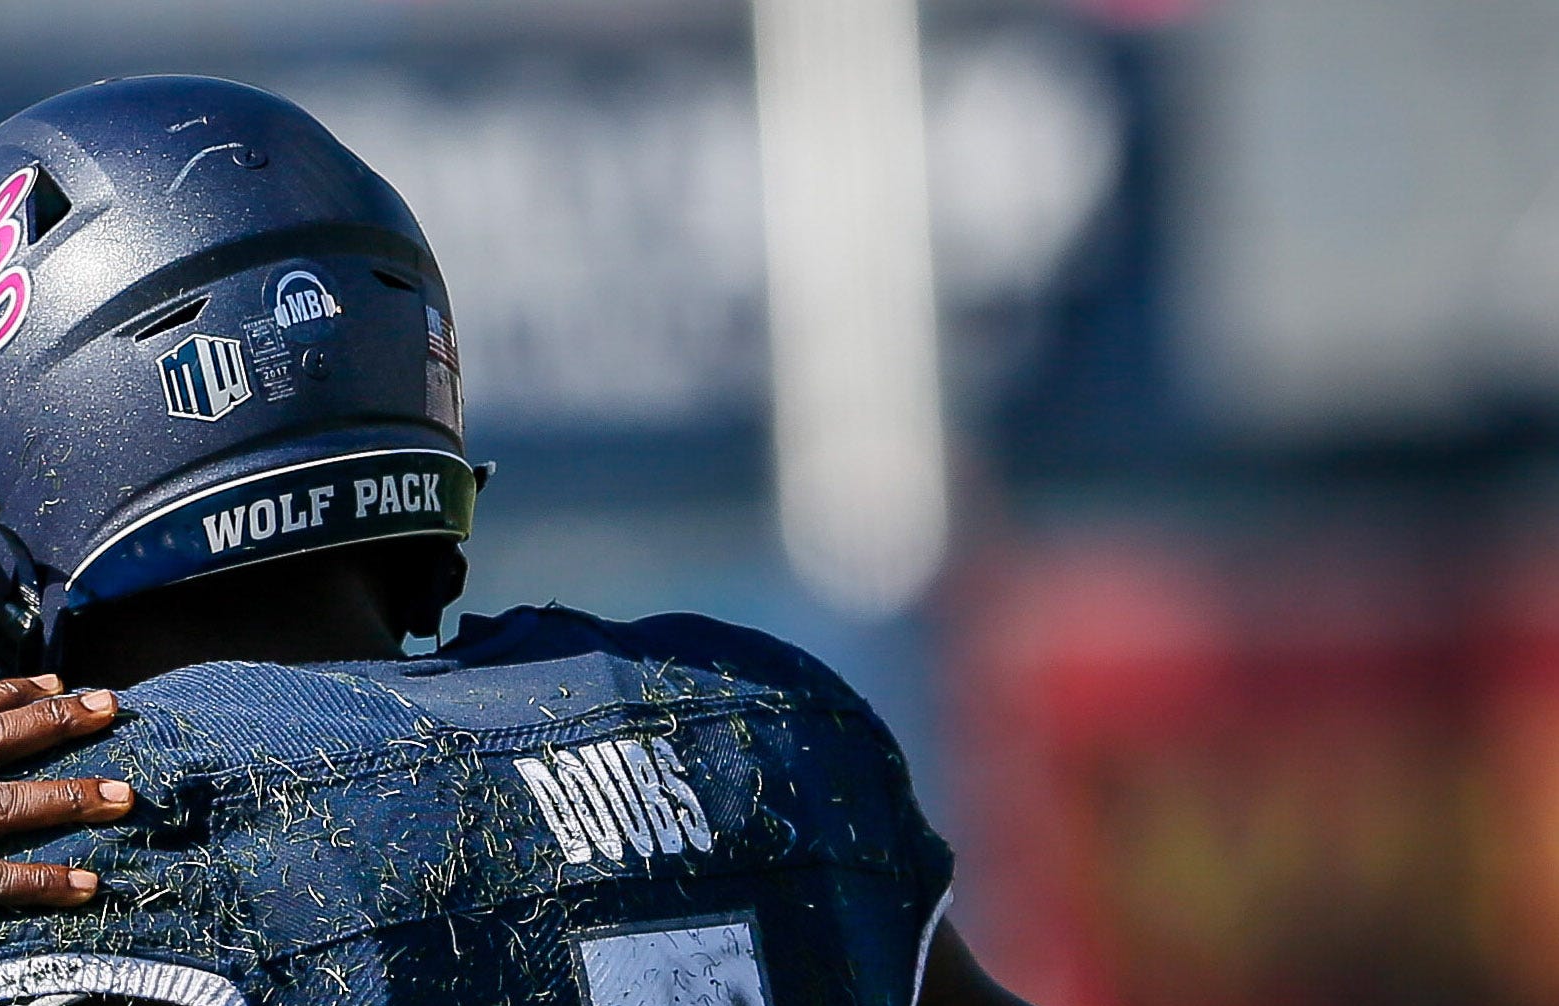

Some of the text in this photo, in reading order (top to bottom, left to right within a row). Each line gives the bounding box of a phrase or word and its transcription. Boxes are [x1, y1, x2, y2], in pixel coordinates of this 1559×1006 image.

[263, 366, 289, 380] 2017
[202, 473, 441, 554] WOLF PACK
[512, 737, 712, 864] DOUBS
